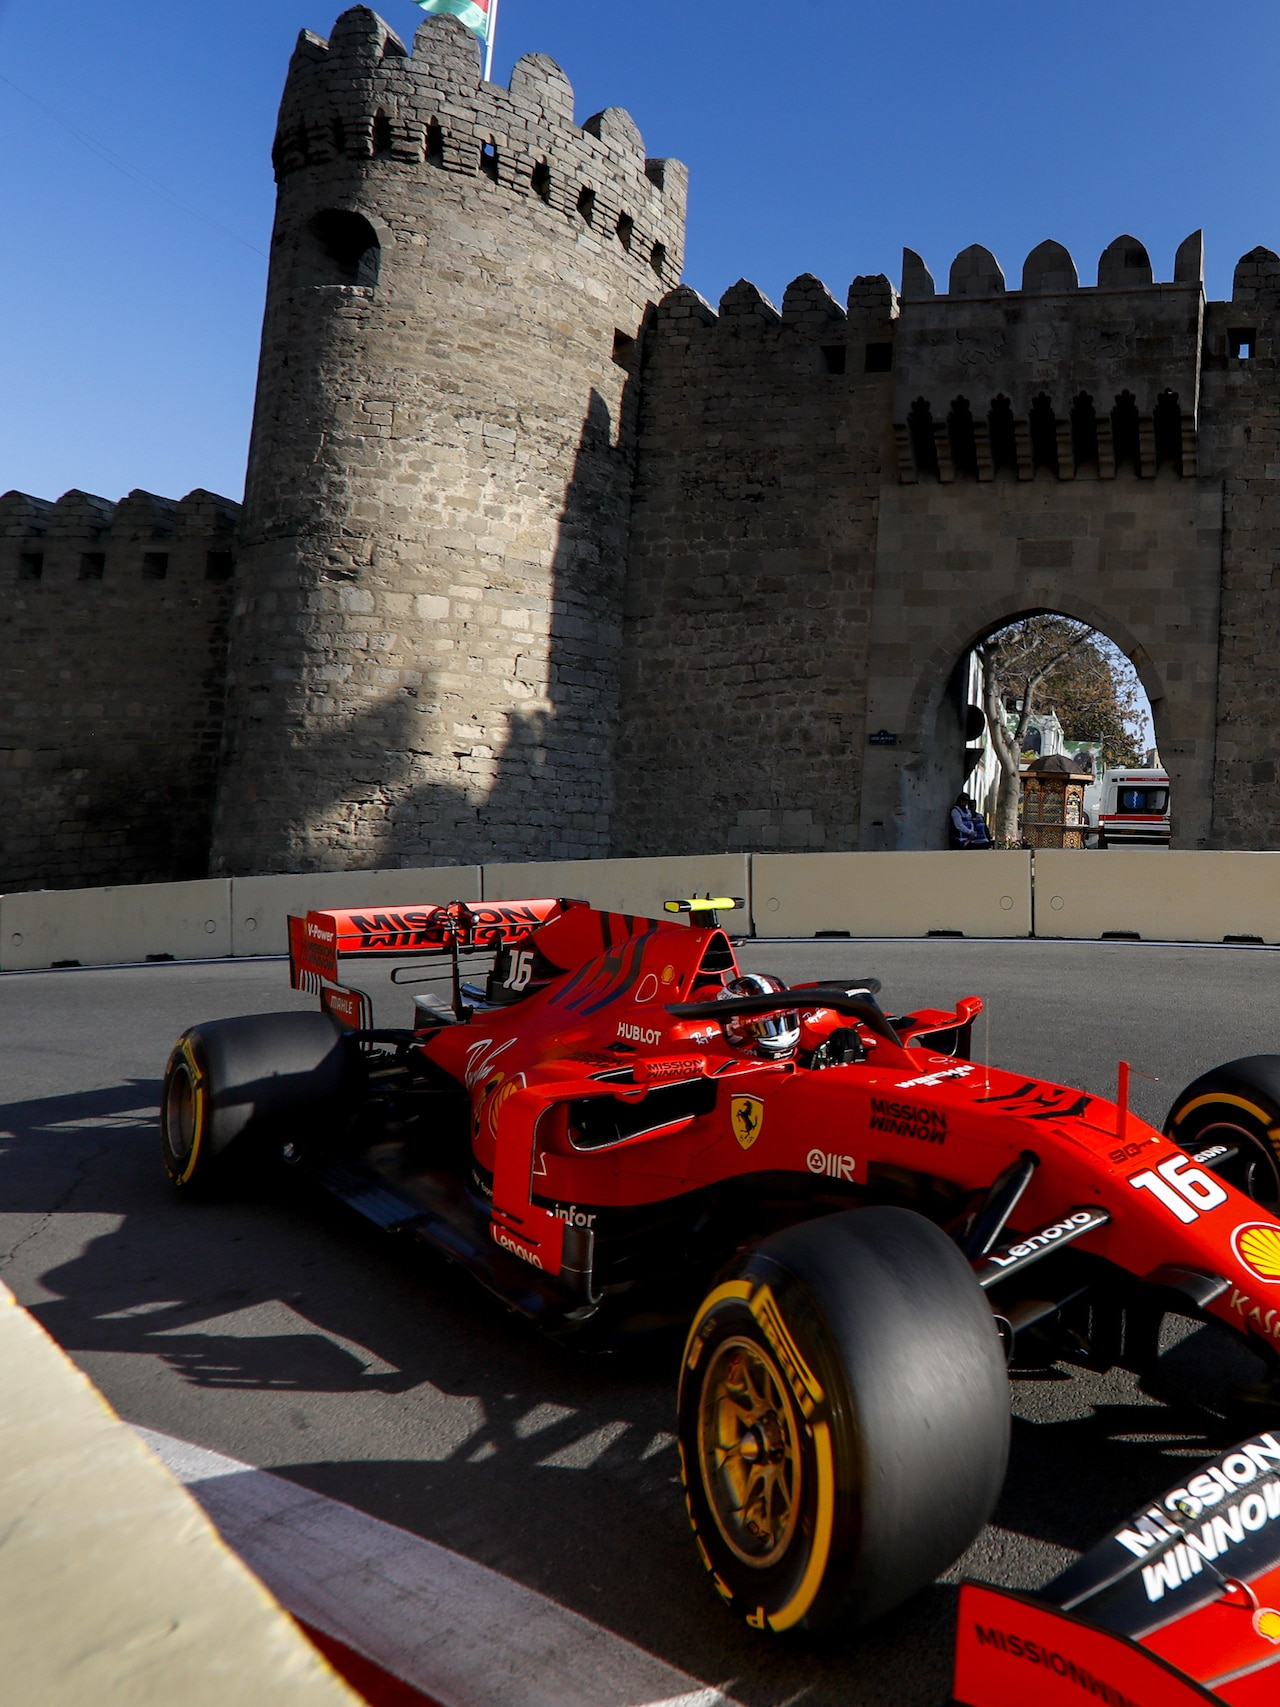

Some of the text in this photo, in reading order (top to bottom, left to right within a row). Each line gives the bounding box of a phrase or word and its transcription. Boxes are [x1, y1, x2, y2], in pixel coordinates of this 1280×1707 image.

[307, 923, 334, 942] V-Power
[503, 950, 534, 991] 16
[330, 995, 353, 1014] MAHLE
[617, 1022, 661, 1046] HUBLOT
[647, 1059, 703, 1072] MISSION
[647, 1067, 703, 1079] WINNOW
[871, 1097, 947, 1129] MISSION
[869, 1115, 947, 1145] WINNOW
[1127, 1153, 1229, 1225] 16
[555, 1203, 597, 1228] infor
[493, 1224, 543, 1270] Lenovo
[988, 1212, 1092, 1268] Lenovo
